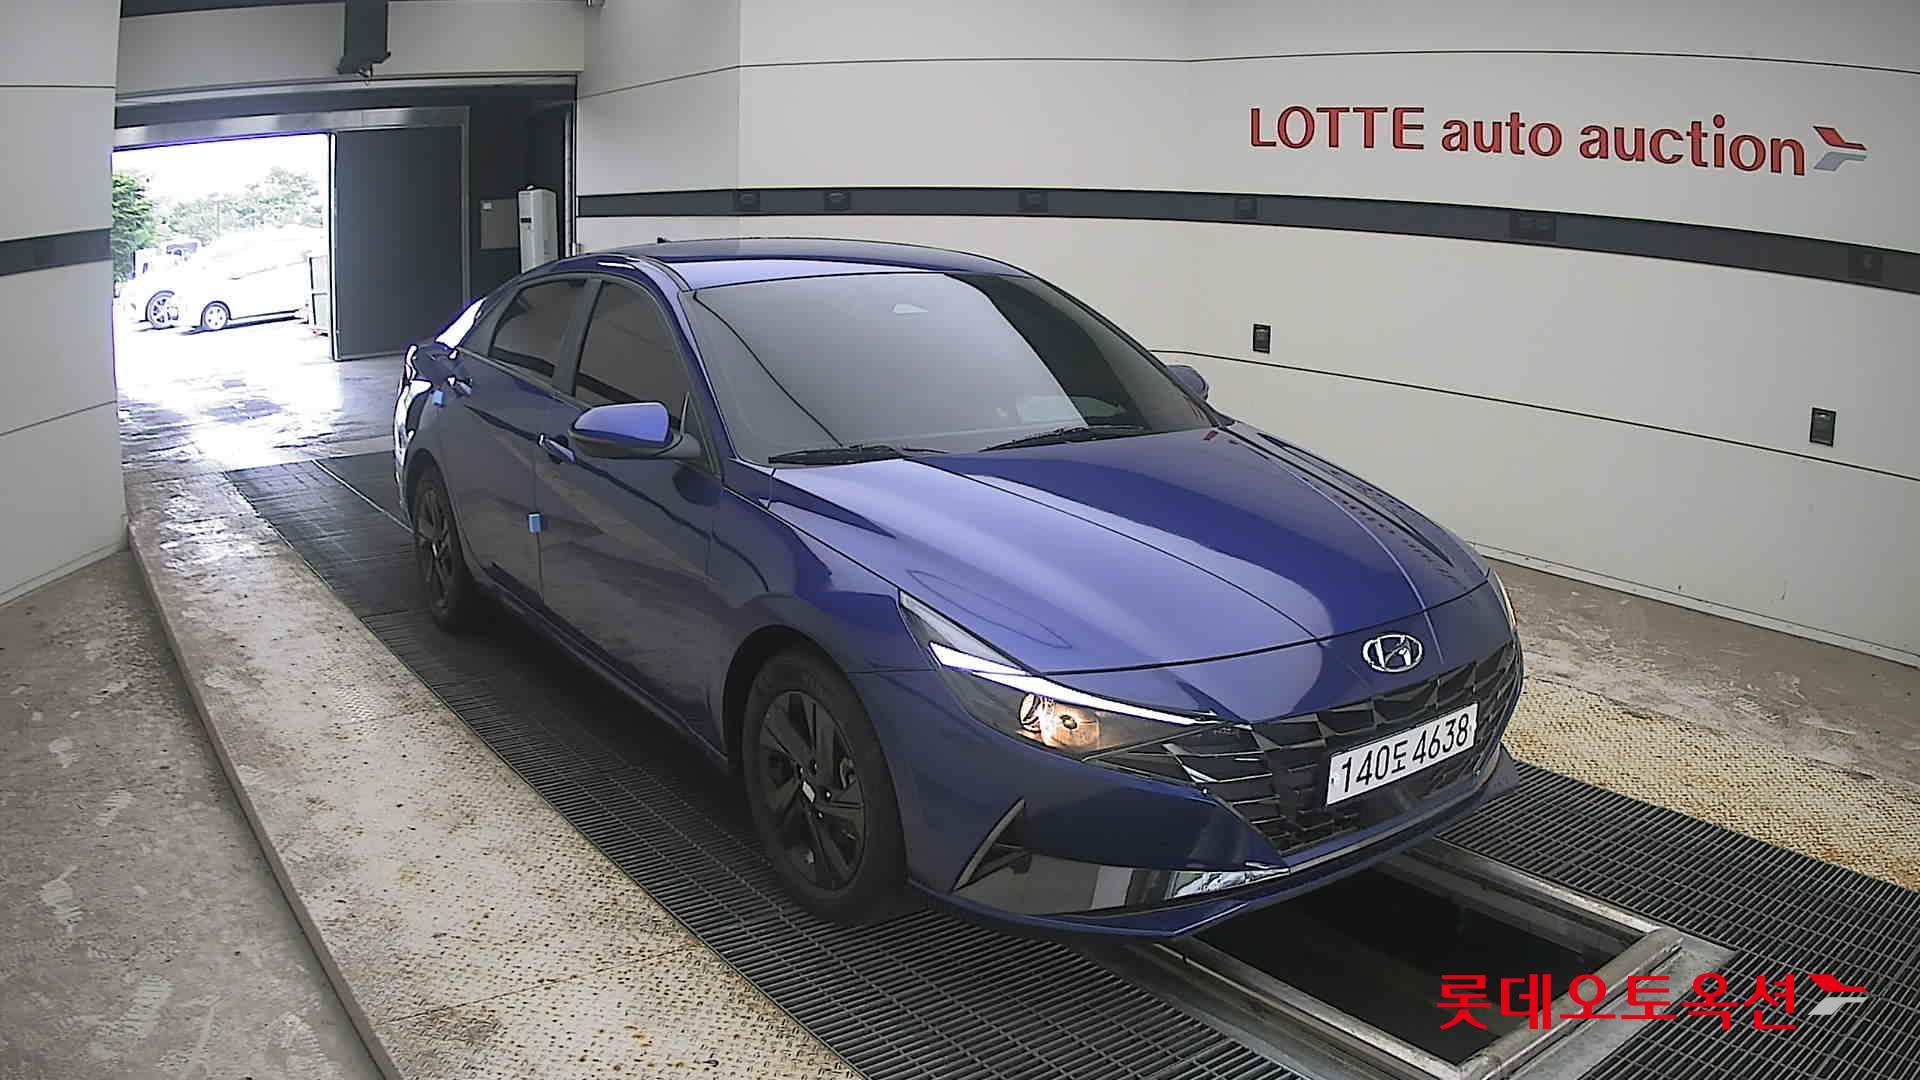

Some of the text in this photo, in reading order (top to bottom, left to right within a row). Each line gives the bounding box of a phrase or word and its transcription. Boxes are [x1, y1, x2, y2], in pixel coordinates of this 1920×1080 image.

[1250, 106, 1806, 176] LOTTE auto auction
[1341, 712, 1470, 793] 140도 4638
